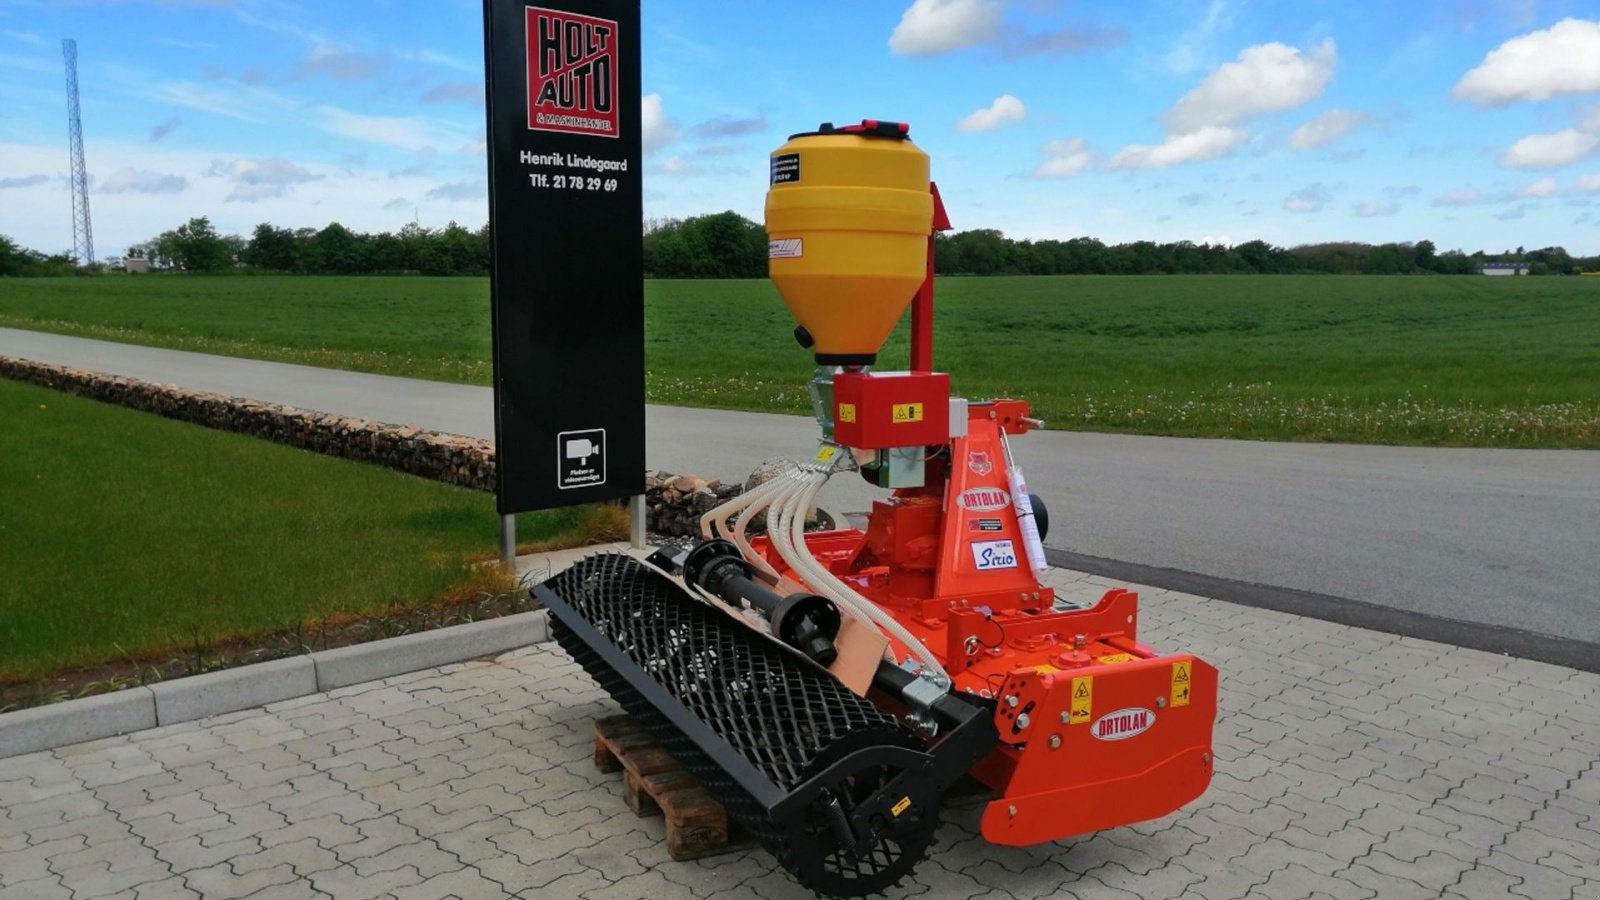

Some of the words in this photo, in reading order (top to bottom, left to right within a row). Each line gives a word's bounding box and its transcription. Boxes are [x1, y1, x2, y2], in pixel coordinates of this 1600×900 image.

[537, 15, 611, 78] HOLT
[535, 53, 612, 114] AUTO
[520, 150, 564, 166] Henrik
[567, 153, 628, 172] Lindegaard
[529, 173, 550, 187] Tlf.
[553, 175, 566, 188] 21
[569, 176, 584, 190] 78
[587, 177, 601, 191] 29
[604, 178, 618, 192] 69
[963, 492, 1006, 508] ORTOLAN
[979, 548, 1014, 567] Sirio
[1099, 711, 1148, 736] ORTOLAN
